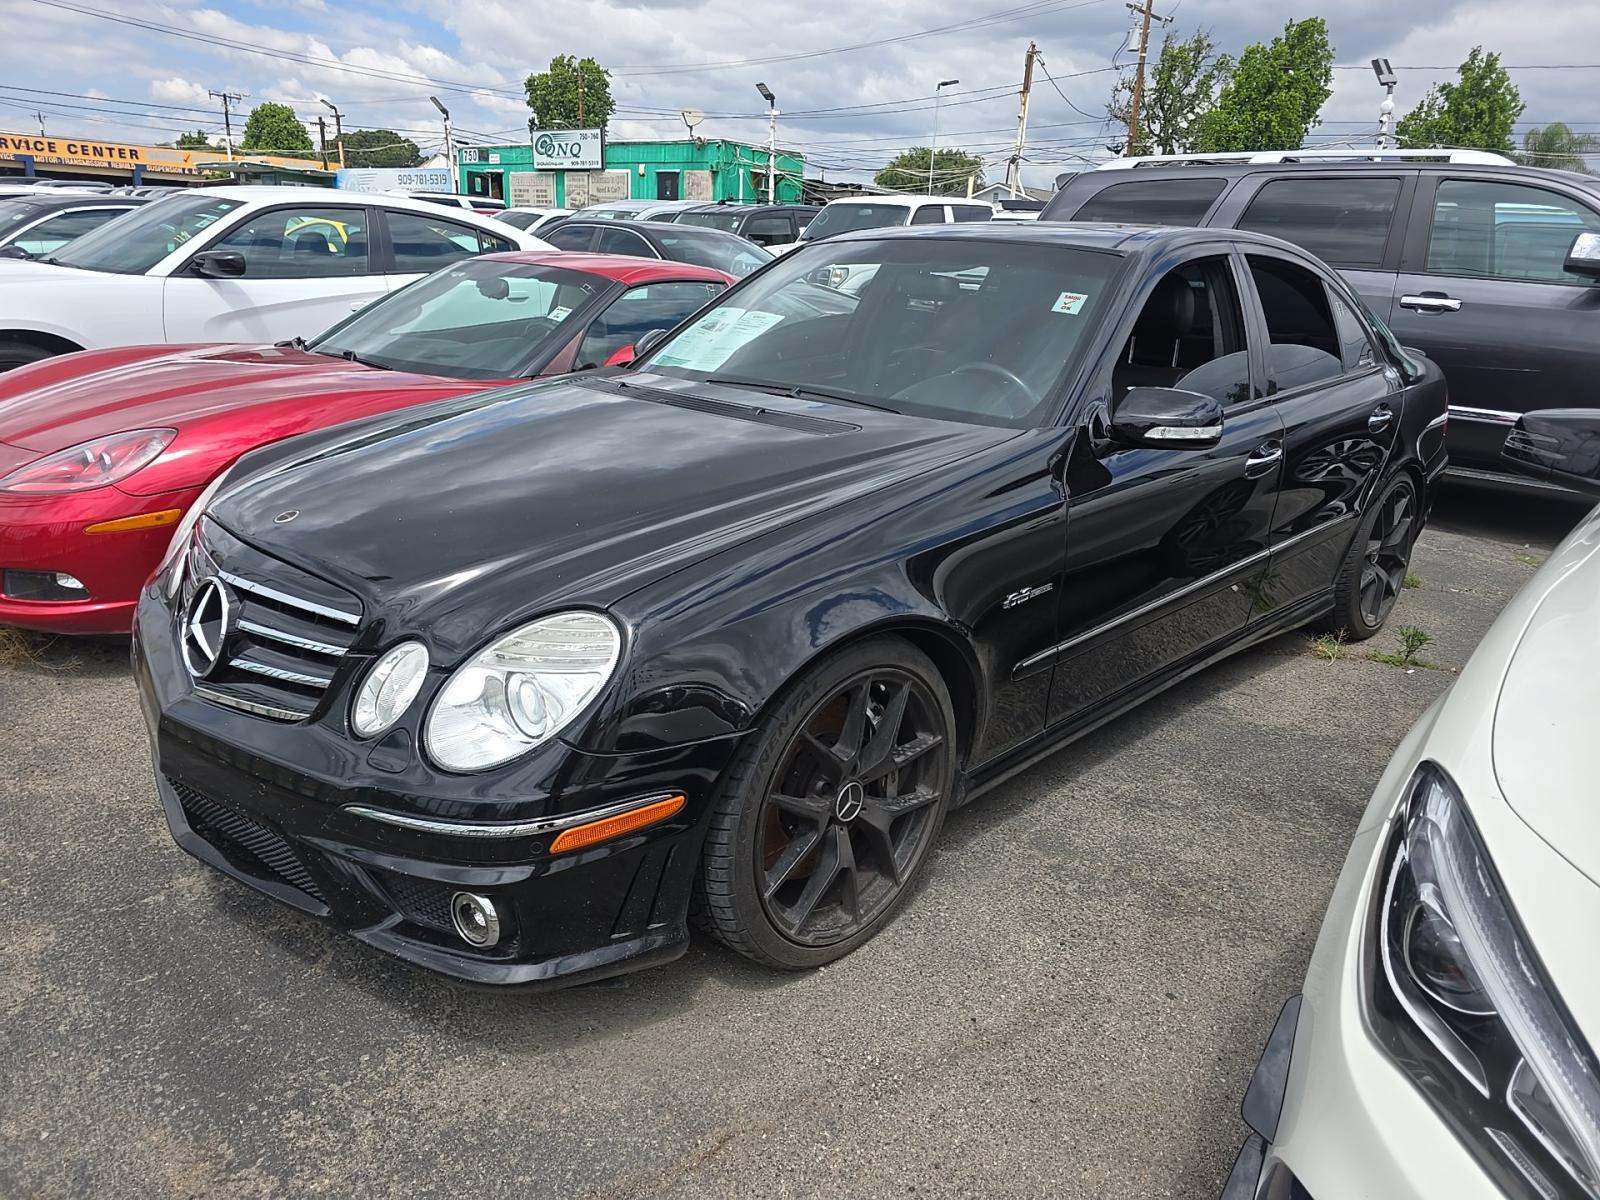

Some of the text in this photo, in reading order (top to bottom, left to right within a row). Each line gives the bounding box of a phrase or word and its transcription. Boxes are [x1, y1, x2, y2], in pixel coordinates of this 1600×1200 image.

[67, 144, 139, 160] CENTER
[464, 150, 477, 162] 750
[397, 174, 447, 185] 909-781-5319
